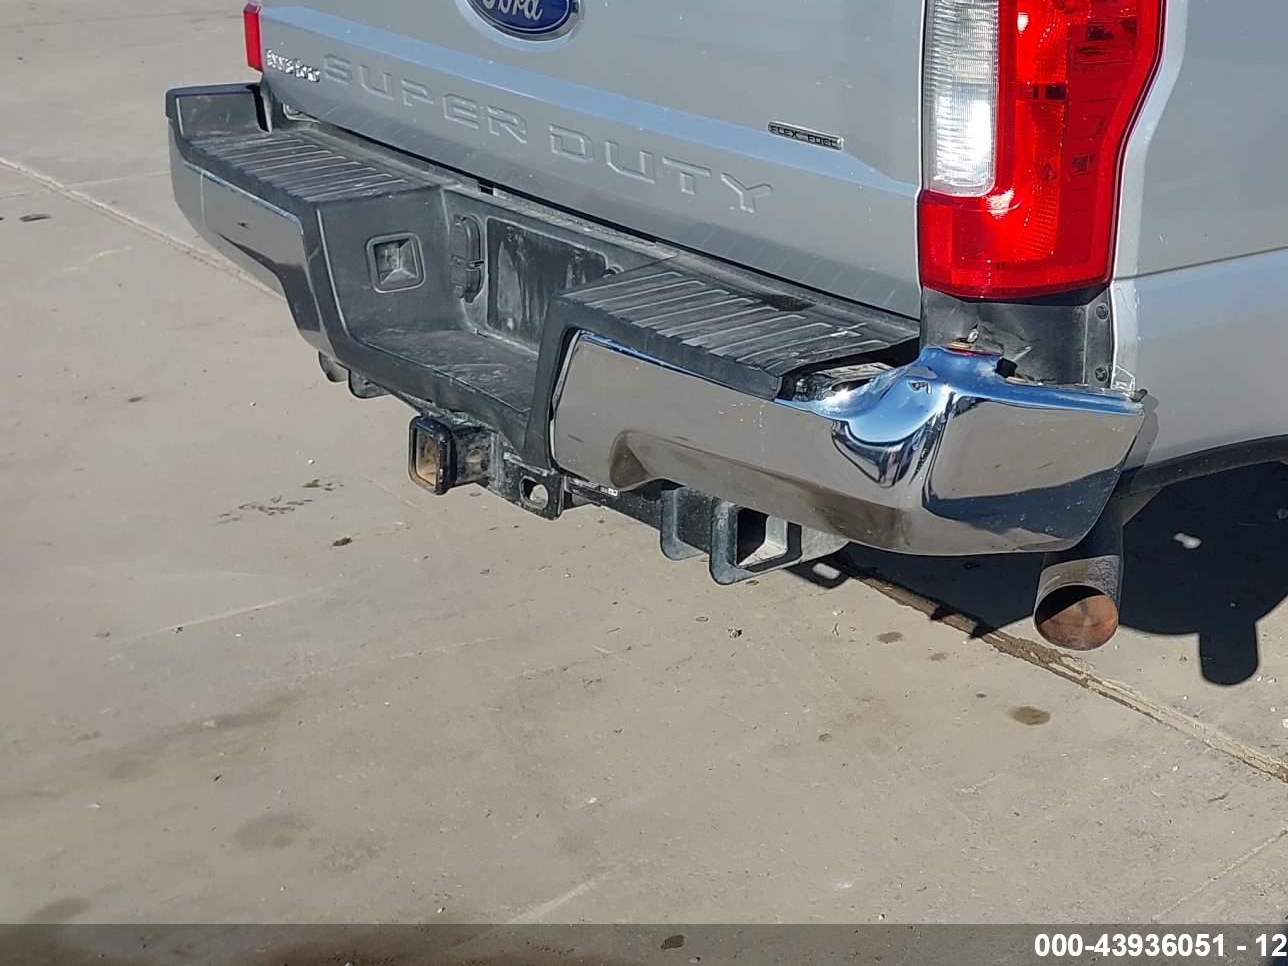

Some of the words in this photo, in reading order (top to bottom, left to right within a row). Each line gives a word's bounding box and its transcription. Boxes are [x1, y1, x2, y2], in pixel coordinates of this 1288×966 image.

[322, 53, 528, 144] SUPER
[548, 122, 774, 213] DUTY
[769, 125, 799, 139] FLEX
[807, 134, 837, 147] FUEL
